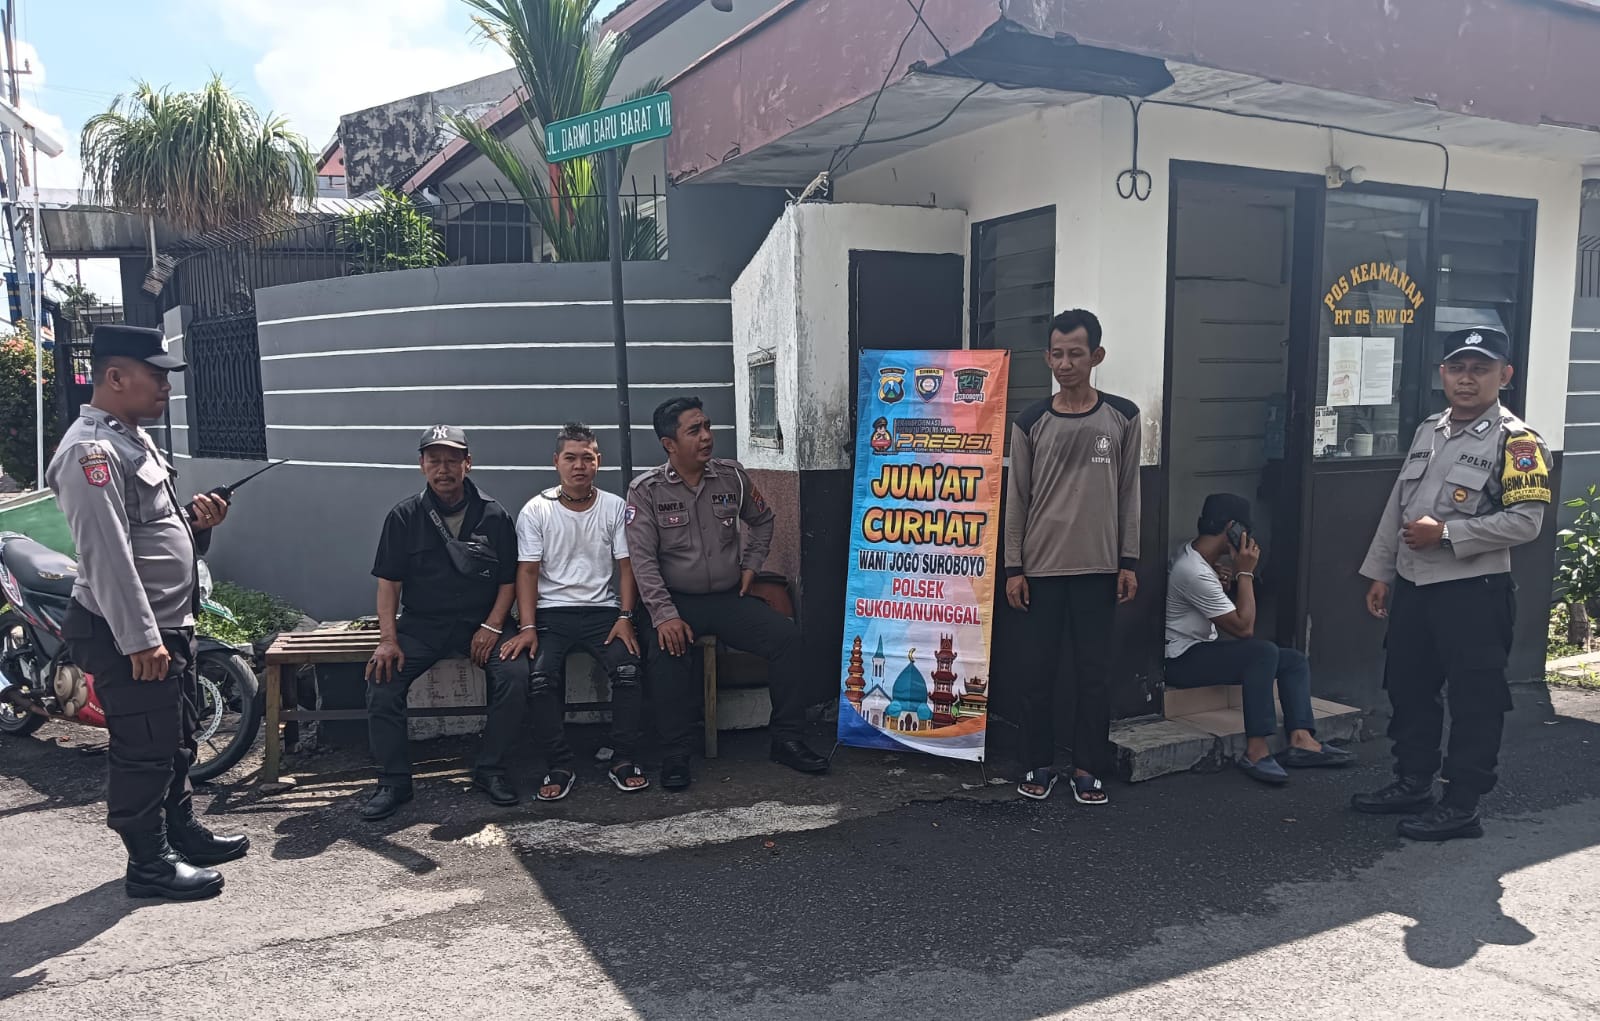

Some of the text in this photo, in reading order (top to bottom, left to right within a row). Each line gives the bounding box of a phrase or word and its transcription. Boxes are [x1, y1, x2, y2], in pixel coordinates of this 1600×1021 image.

[547, 132, 560, 155] JL.
[562, 122, 591, 151] DARMO
[593, 114, 617, 144] BARU
[620, 105, 652, 137] BARAT
[1324, 261, 1425, 312] POS KEAMANAN
[1334, 309, 1414, 325] RT 05 RW 02
[896, 433, 992, 450] PRESISI
[1459, 454, 1493, 469] POLRI
[872, 464, 982, 502] JUM'AT
[863, 508, 986, 547] CURHAT
[859, 550, 985, 576] WANI JOGO SUROBOYO
[893, 578, 944, 599] POLSEK
[855, 599, 981, 625] SUKOMANUNGGAL
